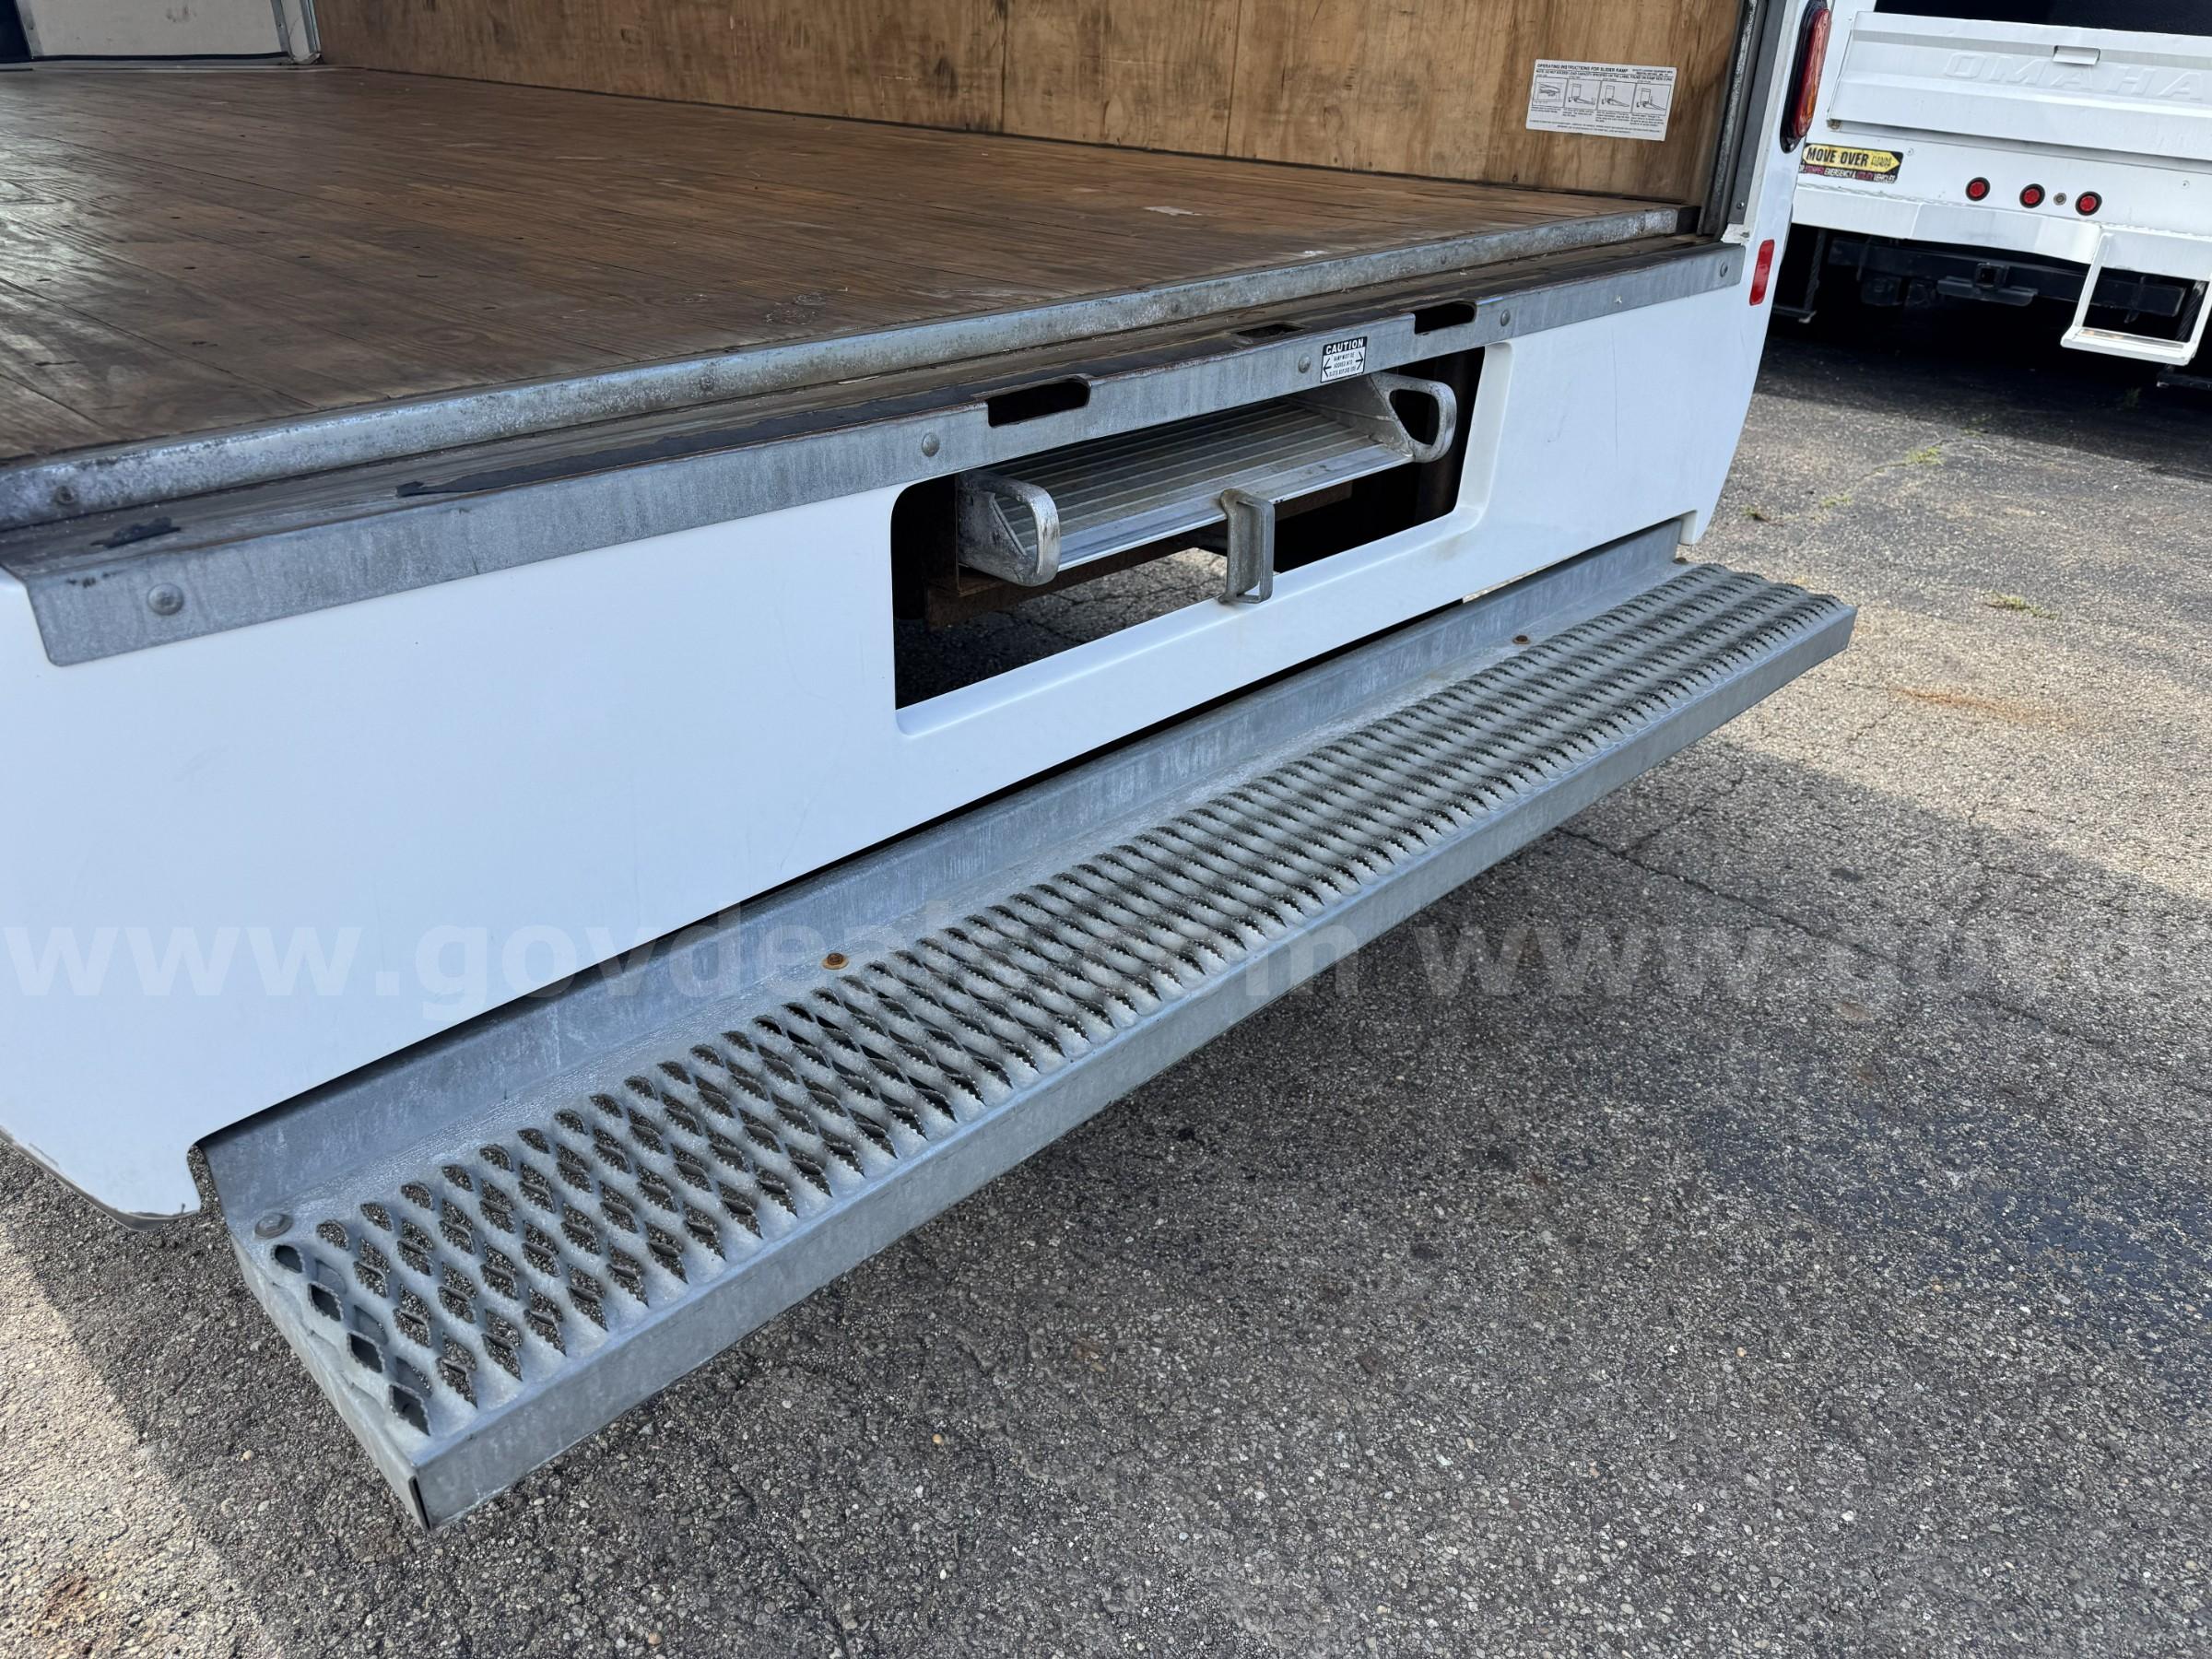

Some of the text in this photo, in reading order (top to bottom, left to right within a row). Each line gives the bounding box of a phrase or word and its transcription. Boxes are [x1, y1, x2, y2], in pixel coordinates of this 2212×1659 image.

[1943, 52, 2206, 102] OMAHA
[1806, 147, 1837, 163] MOVE
[1840, 151, 1869, 167] OVER
[1325, 338, 1364, 355] CAUTION
